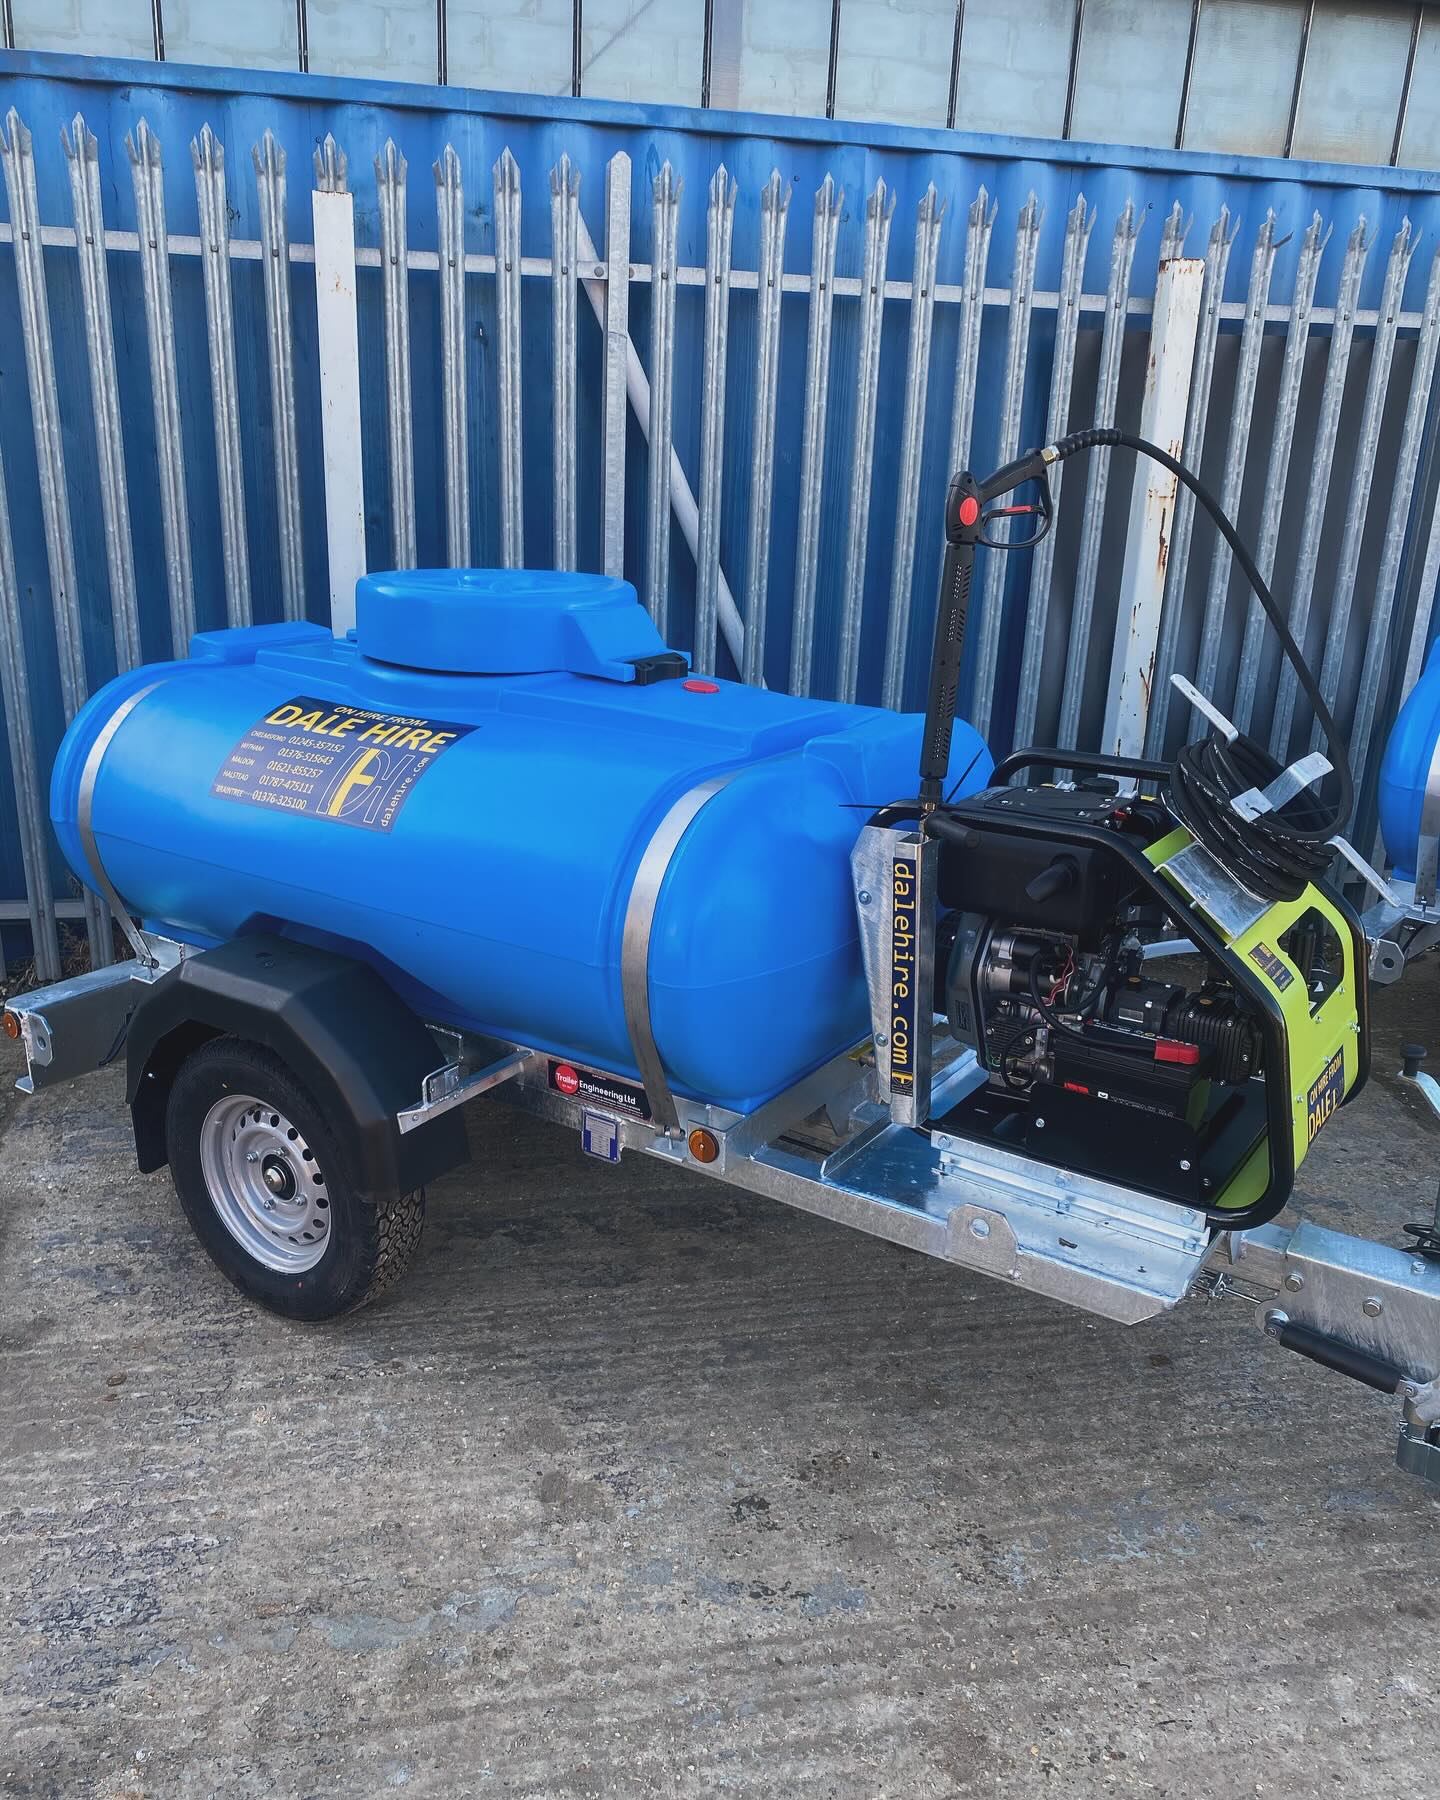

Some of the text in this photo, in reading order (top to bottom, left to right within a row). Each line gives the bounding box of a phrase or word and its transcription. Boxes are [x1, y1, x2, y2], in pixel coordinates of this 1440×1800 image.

[265, 705, 457, 753] DALE HIRE
[334, 706, 428, 726] ON HIRE FROM
[252, 790, 307, 809] 01376-325100
[381, 757, 430, 827] dalehire.com
[892, 863, 915, 1065] dalehire.com
[555, 1072, 578, 1086] Trailer
[579, 1080, 624, 1103] Engineering
[624, 1094, 636, 1105] Ltd
[1308, 1087, 1331, 1142] DALE
